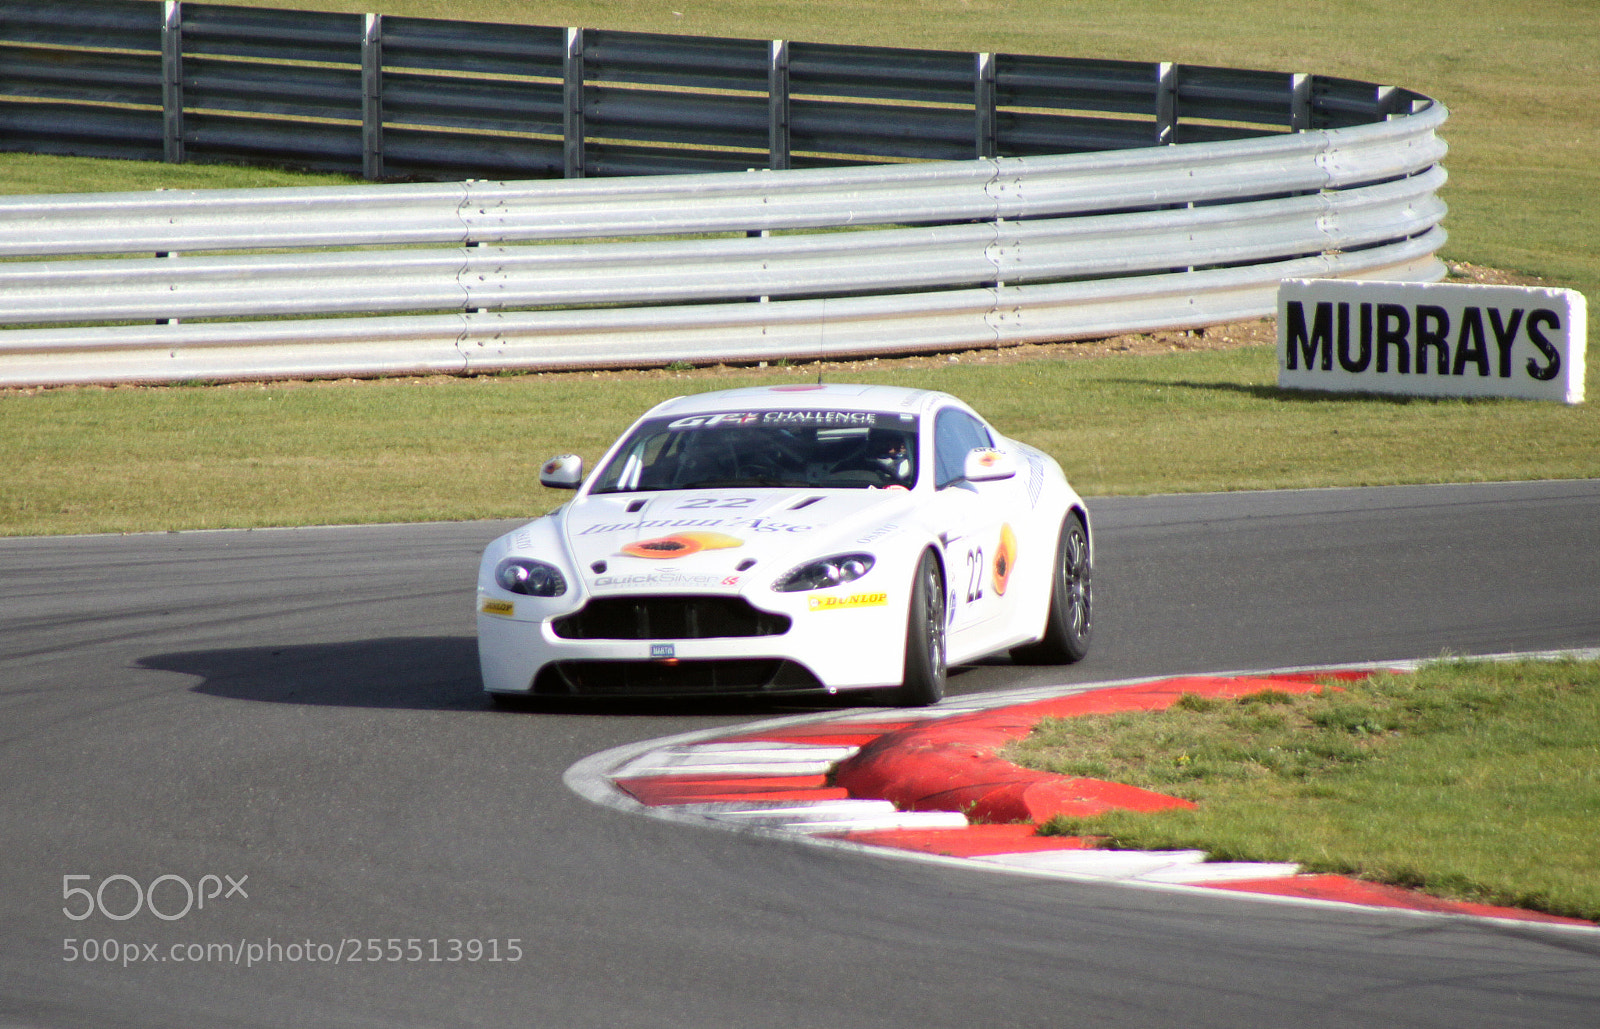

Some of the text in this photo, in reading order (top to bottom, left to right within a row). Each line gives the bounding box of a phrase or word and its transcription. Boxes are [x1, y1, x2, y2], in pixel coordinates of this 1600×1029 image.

[1286, 301, 1561, 380] MURRAYS
[764, 411, 876, 420] CHALLENGE
[675, 497, 757, 509] 22
[965, 544, 984, 604] 22
[825, 593, 888, 606] DUNLOP
